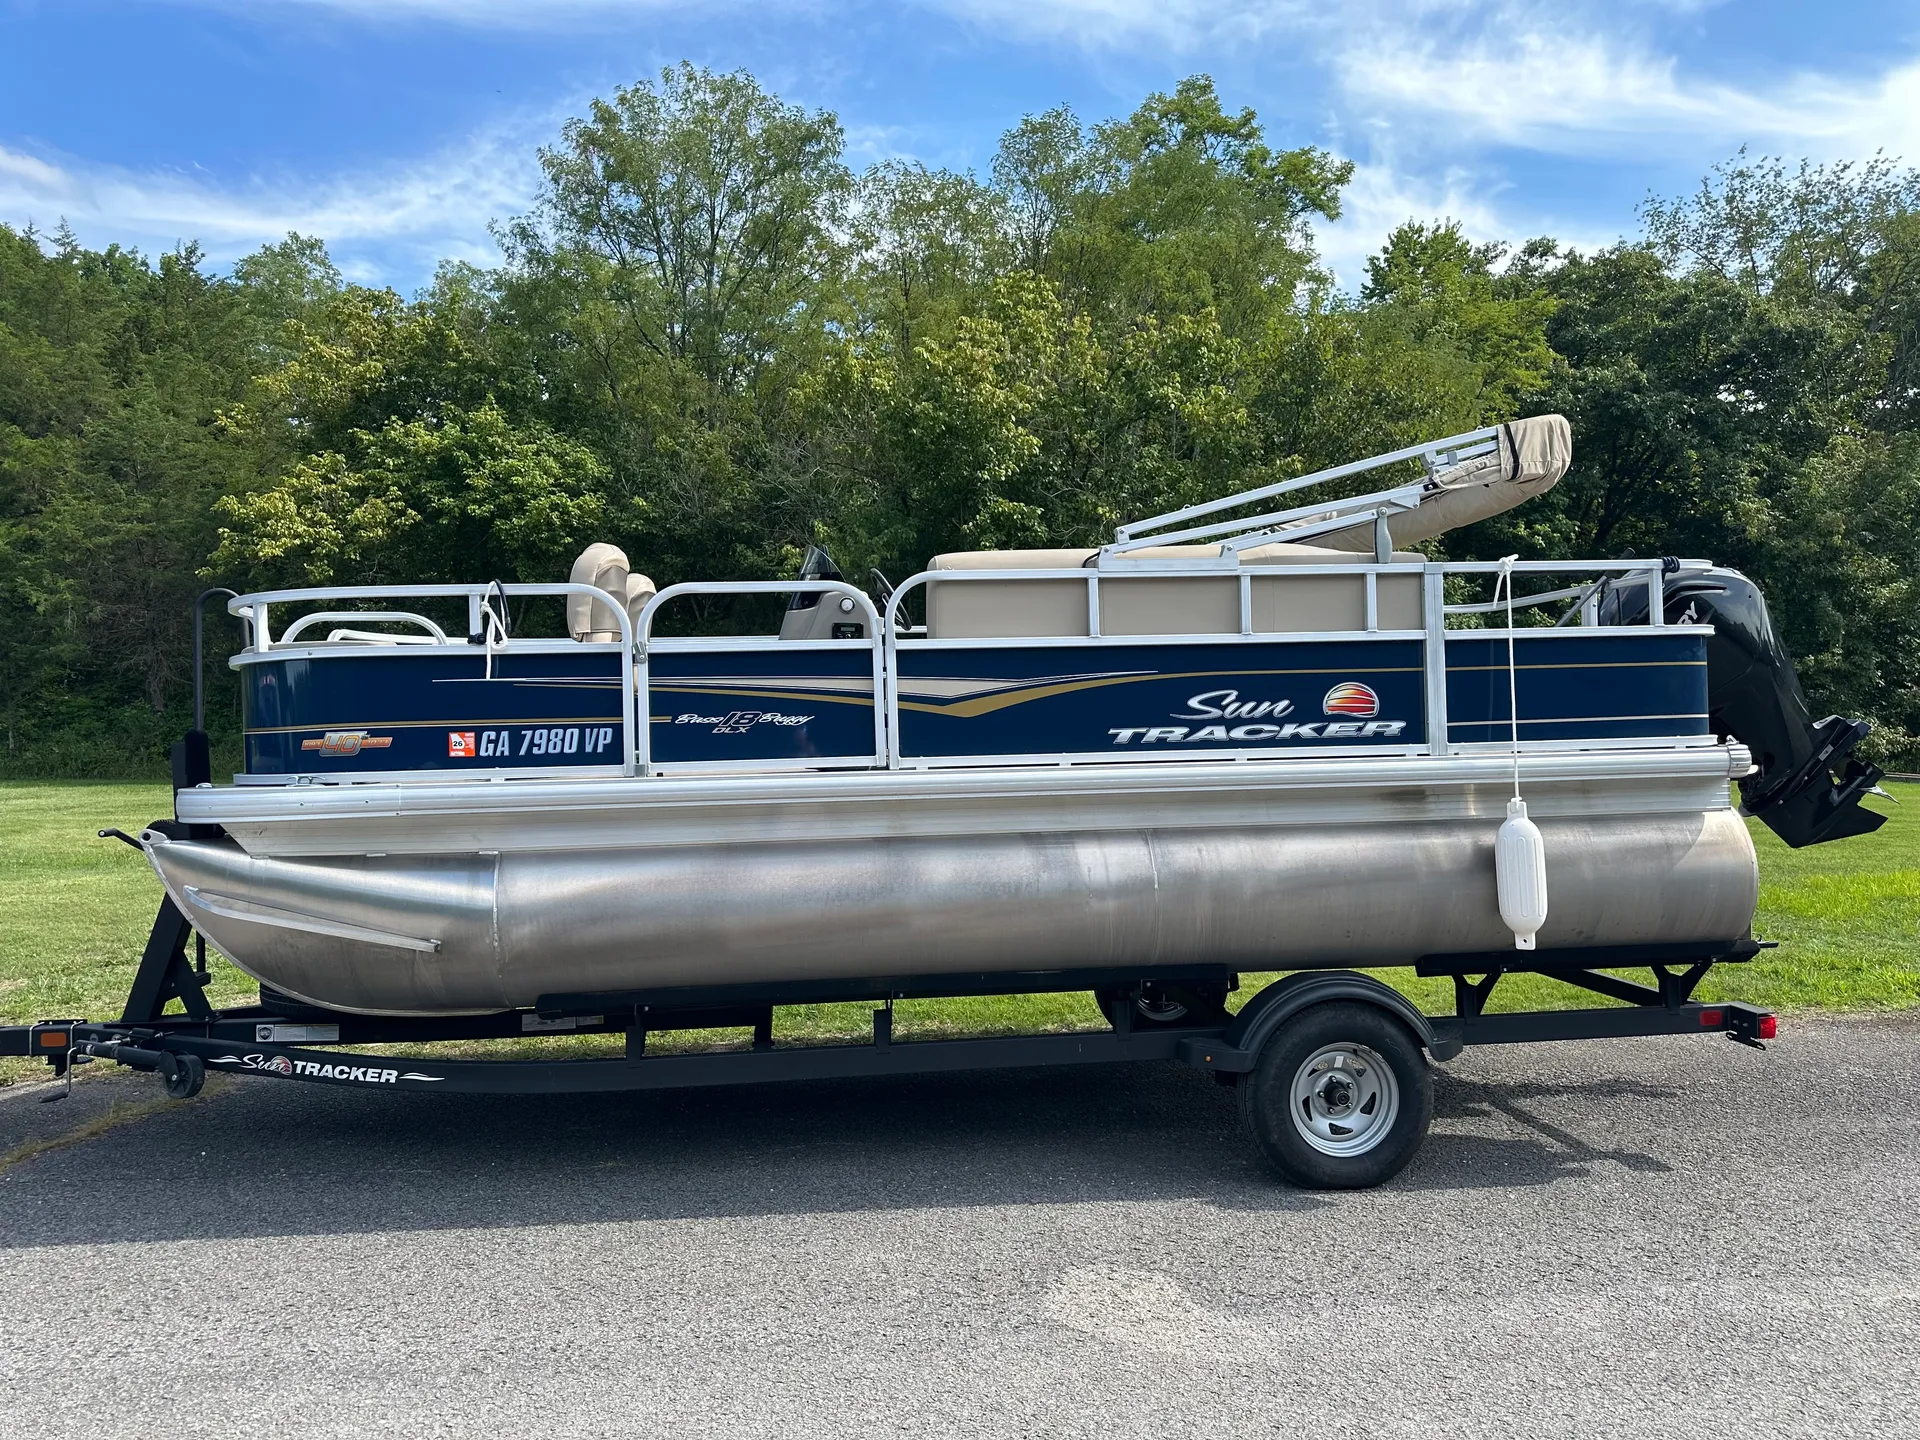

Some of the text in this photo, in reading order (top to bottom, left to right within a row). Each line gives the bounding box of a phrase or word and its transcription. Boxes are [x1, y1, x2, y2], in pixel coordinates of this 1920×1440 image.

[1169, 689, 1295, 720] Sun
[674, 711, 816, 728] Bass 18 Buggy
[1107, 720, 1407, 744] TRACKER
[325, 735, 360, 753] 40
[479, 731, 509, 757] GA
[518, 729, 578, 756] 7980
[584, 727, 613, 754] VP
[239, 1053, 399, 1084] Sun TRACKER
